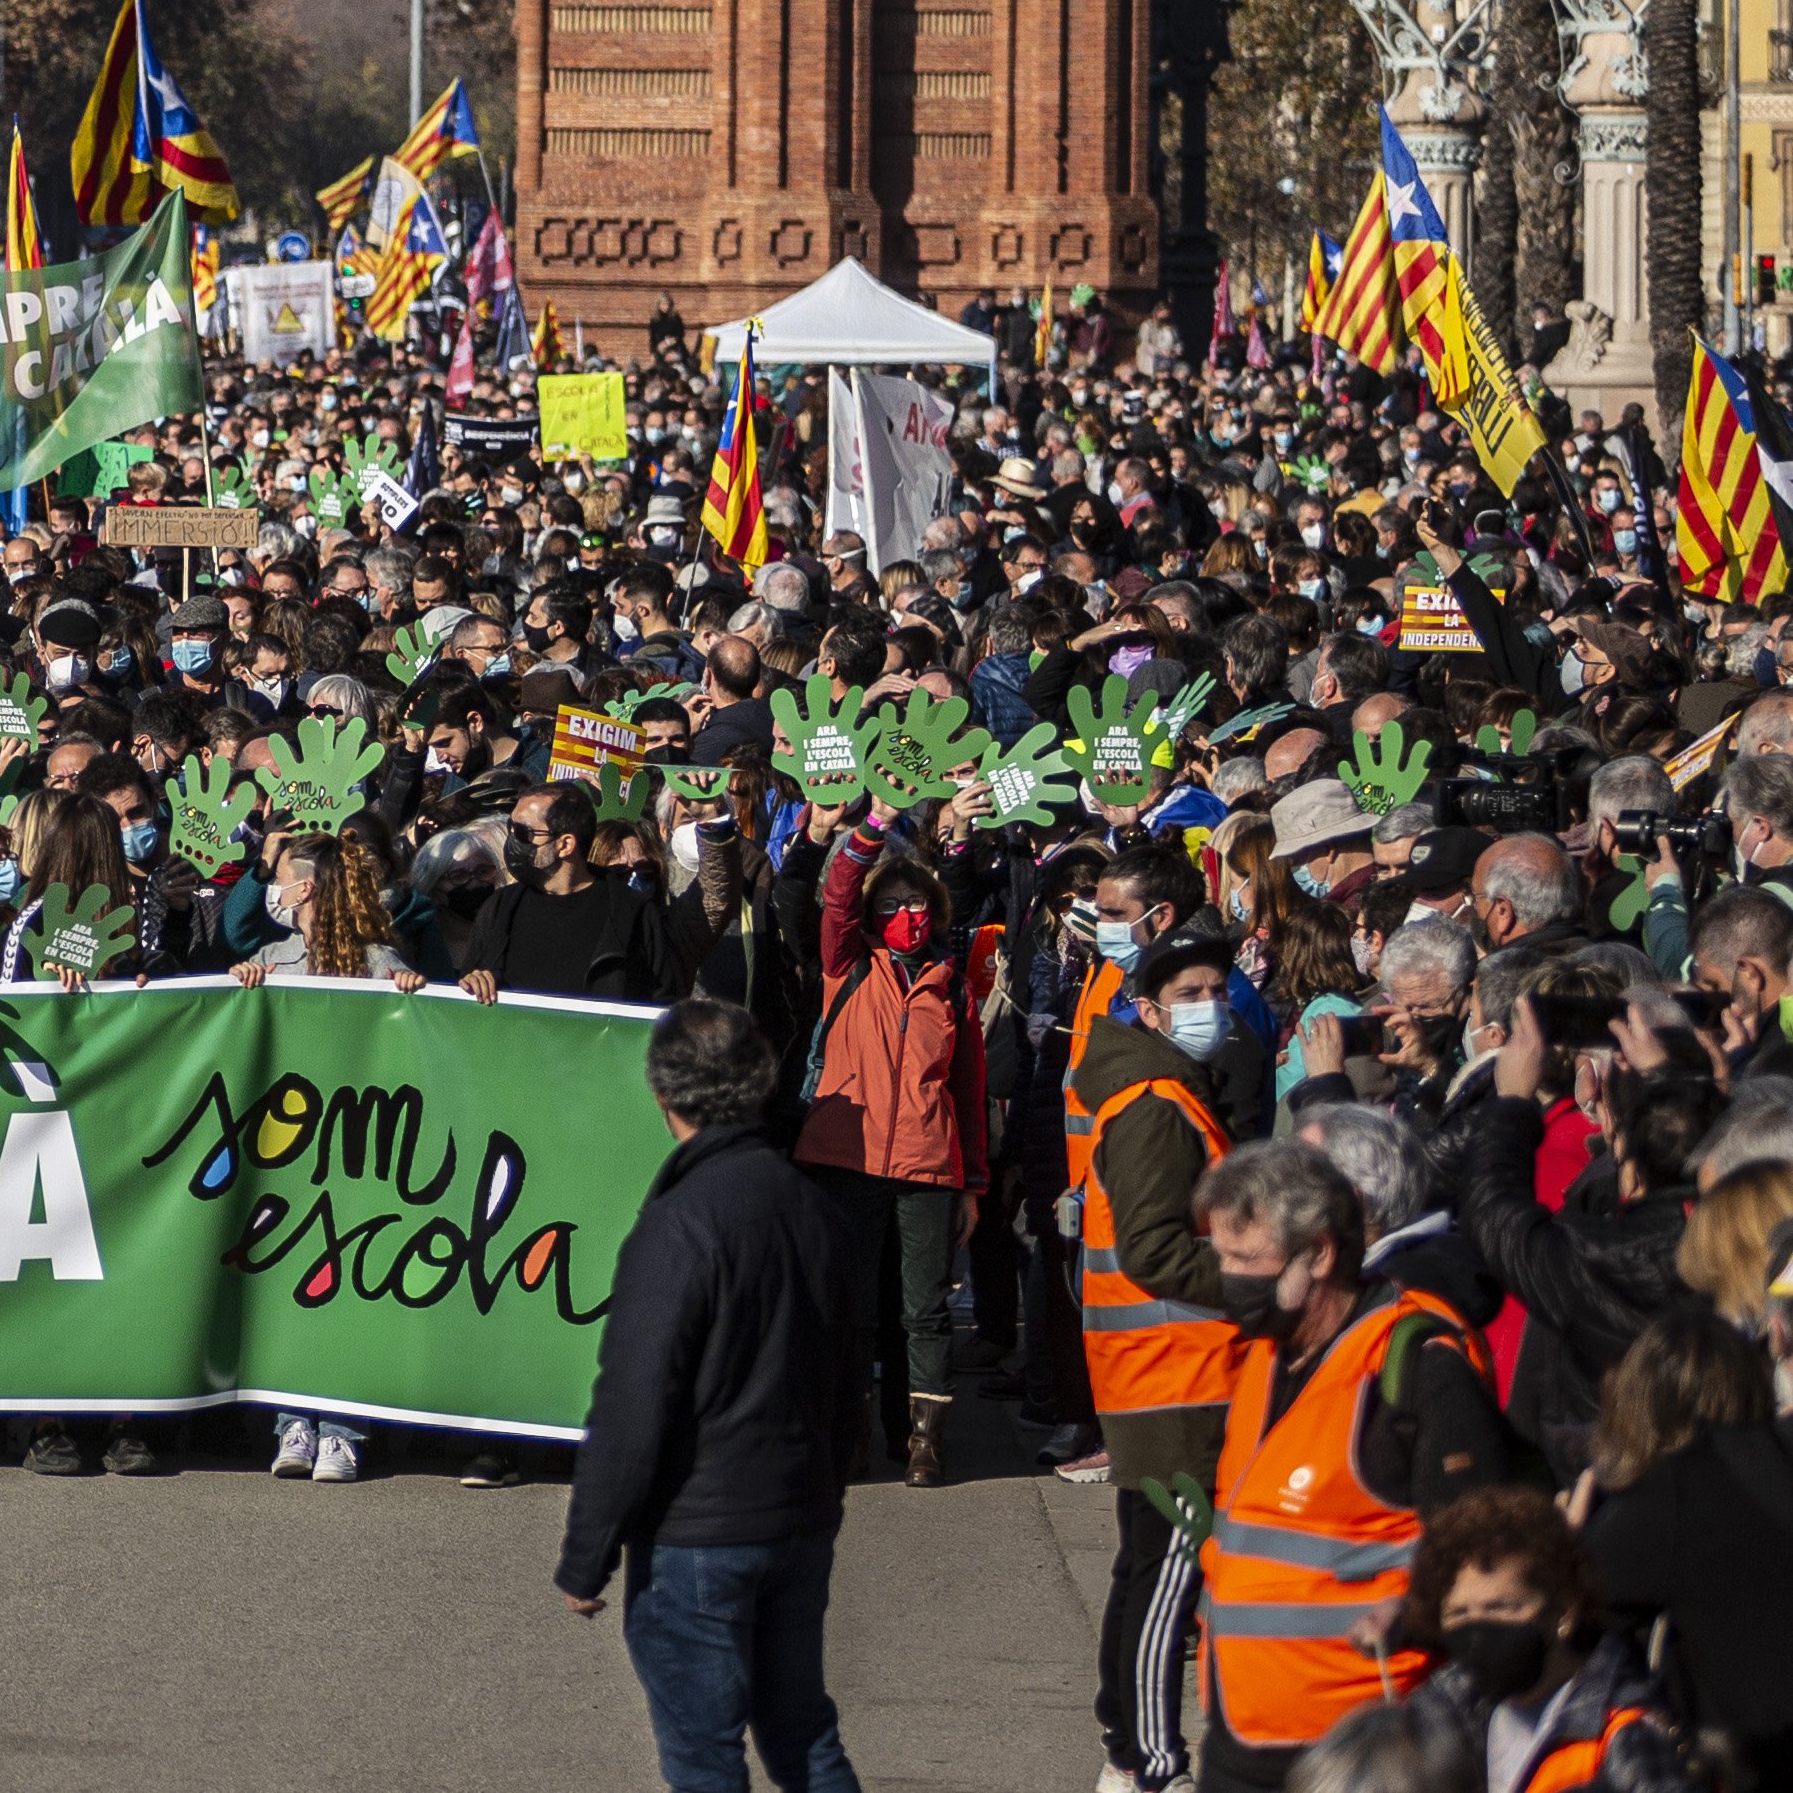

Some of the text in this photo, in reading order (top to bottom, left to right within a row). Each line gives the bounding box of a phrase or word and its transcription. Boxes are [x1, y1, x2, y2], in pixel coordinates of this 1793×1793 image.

[1444, 614, 1459, 627] LA
[568, 714, 637, 752] EXIGIM
[816, 725, 838, 736] ARA
[1107, 725, 1129, 736] ARA
[803, 739, 808, 749] I
[885, 728, 925, 758] som
[1094, 736, 1099, 747] I
[806, 746, 852, 761] L'ESCOLA
[1096, 748, 1140, 759] L'ESCOLA
[804, 760, 818, 772] EN
[886, 745, 936, 784] escola
[1093, 759, 1105, 770] EN
[273, 781, 318, 798] som
[283, 785, 342, 812] escola
[176, 802, 211, 829] som
[180, 819, 227, 850] escola
[54, 927, 60, 937] I
[70, 923, 93, 936] ARA
[43, 945, 59, 958] EN
[52, 937, 95, 957] L'ESCOLA
[142, 1071, 457, 1206] som
[221, 1129, 611, 1325] escola
